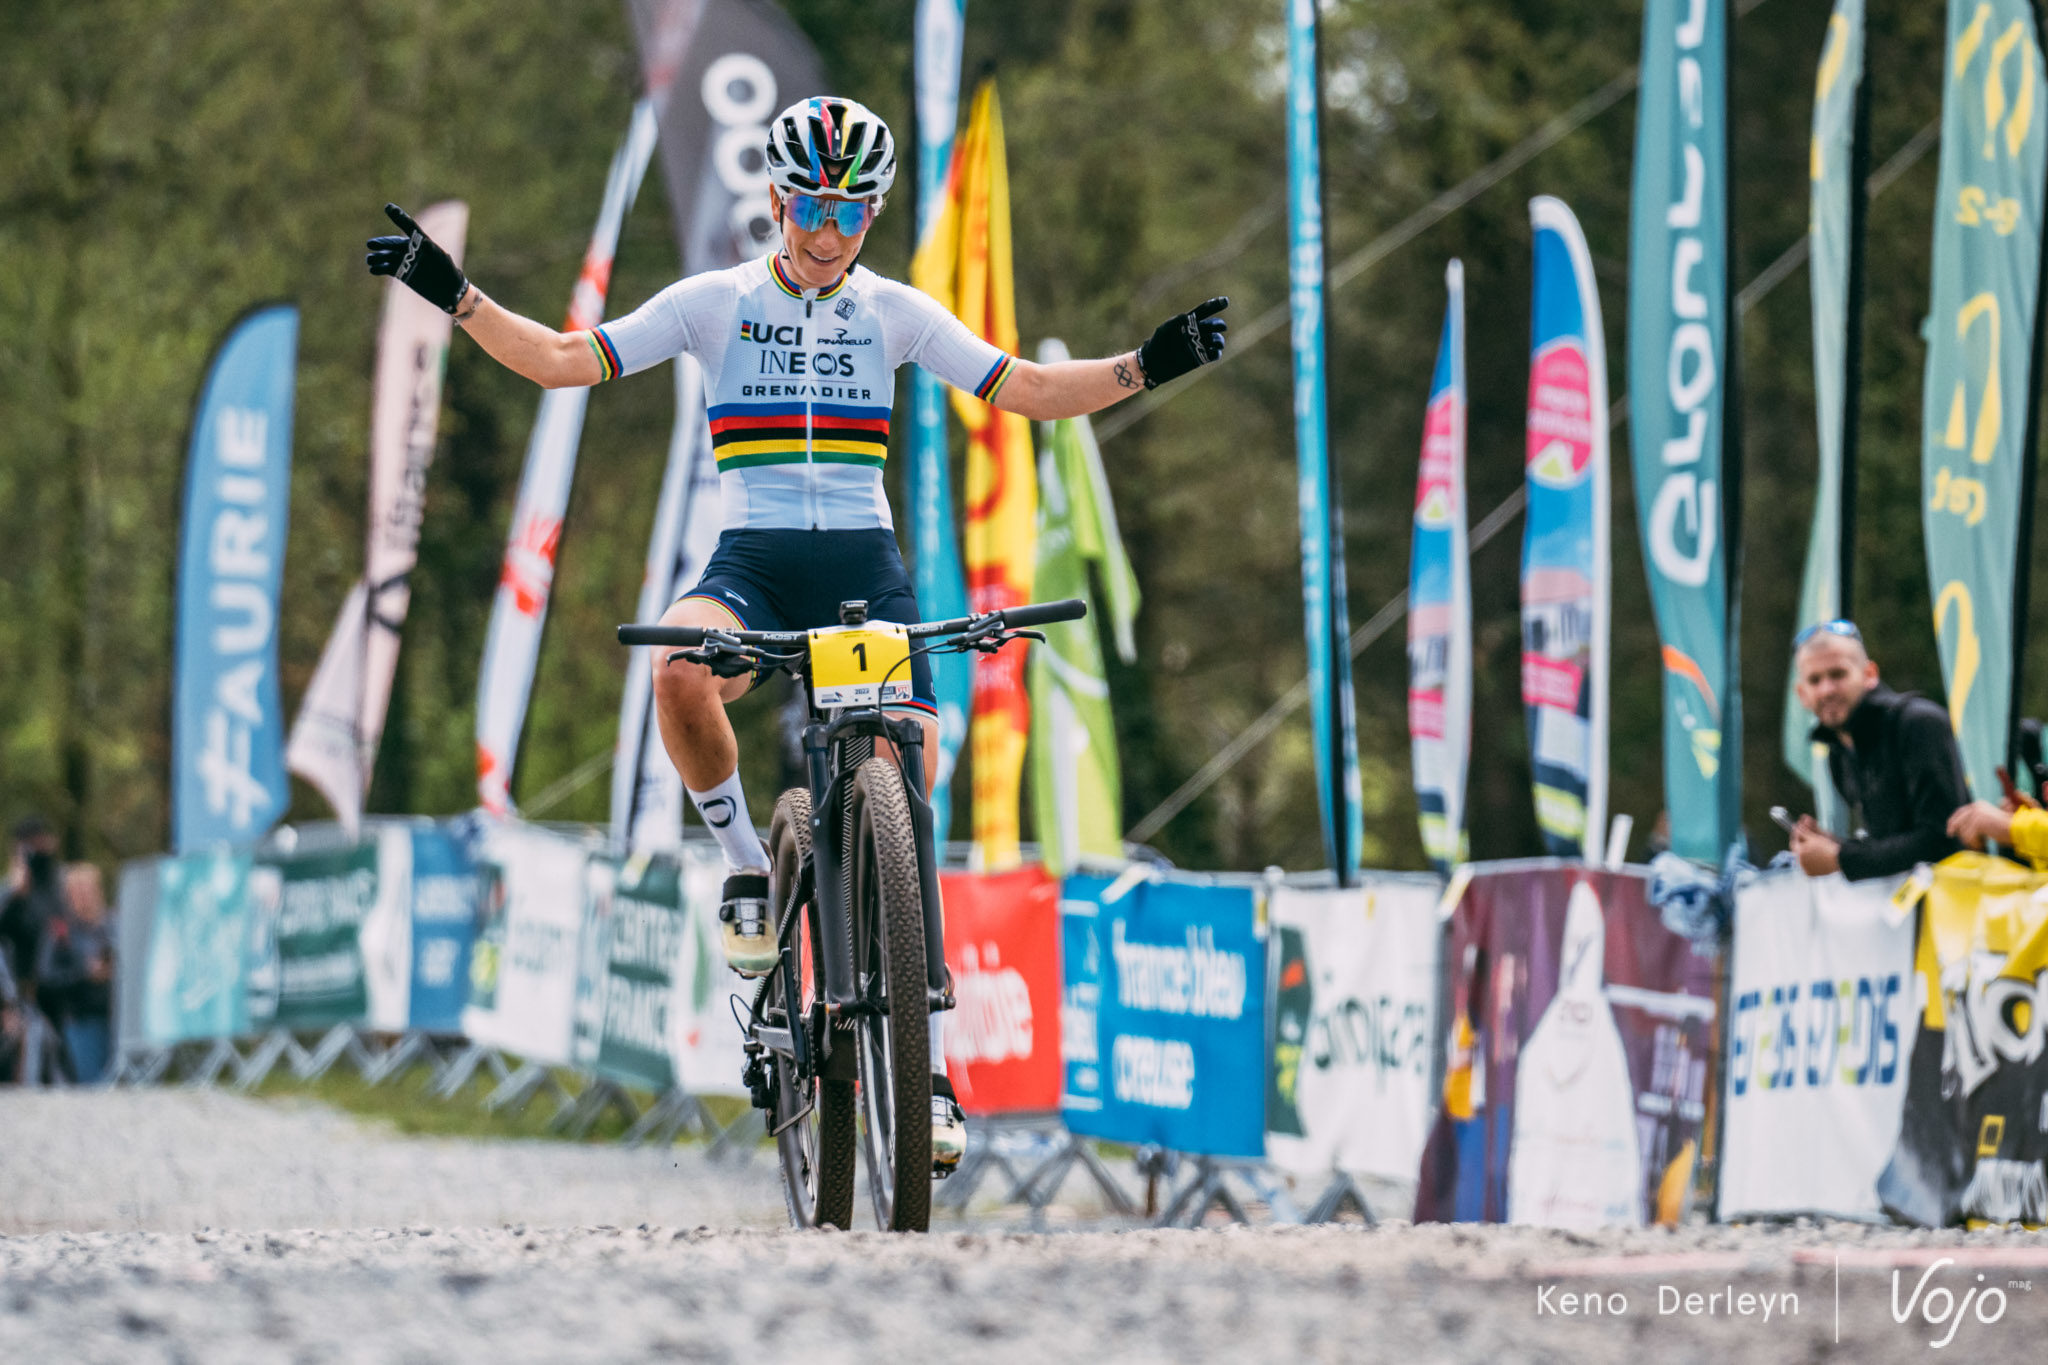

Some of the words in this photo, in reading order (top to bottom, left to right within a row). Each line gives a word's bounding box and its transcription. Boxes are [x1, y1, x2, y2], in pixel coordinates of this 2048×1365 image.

[752, 322, 803, 346] UCI
[817, 337, 872, 346] PINARELLO
[759, 349, 855, 377] INEOS
[742, 385, 872, 399] GRENADIER
[196, 405, 274, 830] FAURIE
[763, 632, 801, 641] MOST
[852, 642, 867, 672] 1
